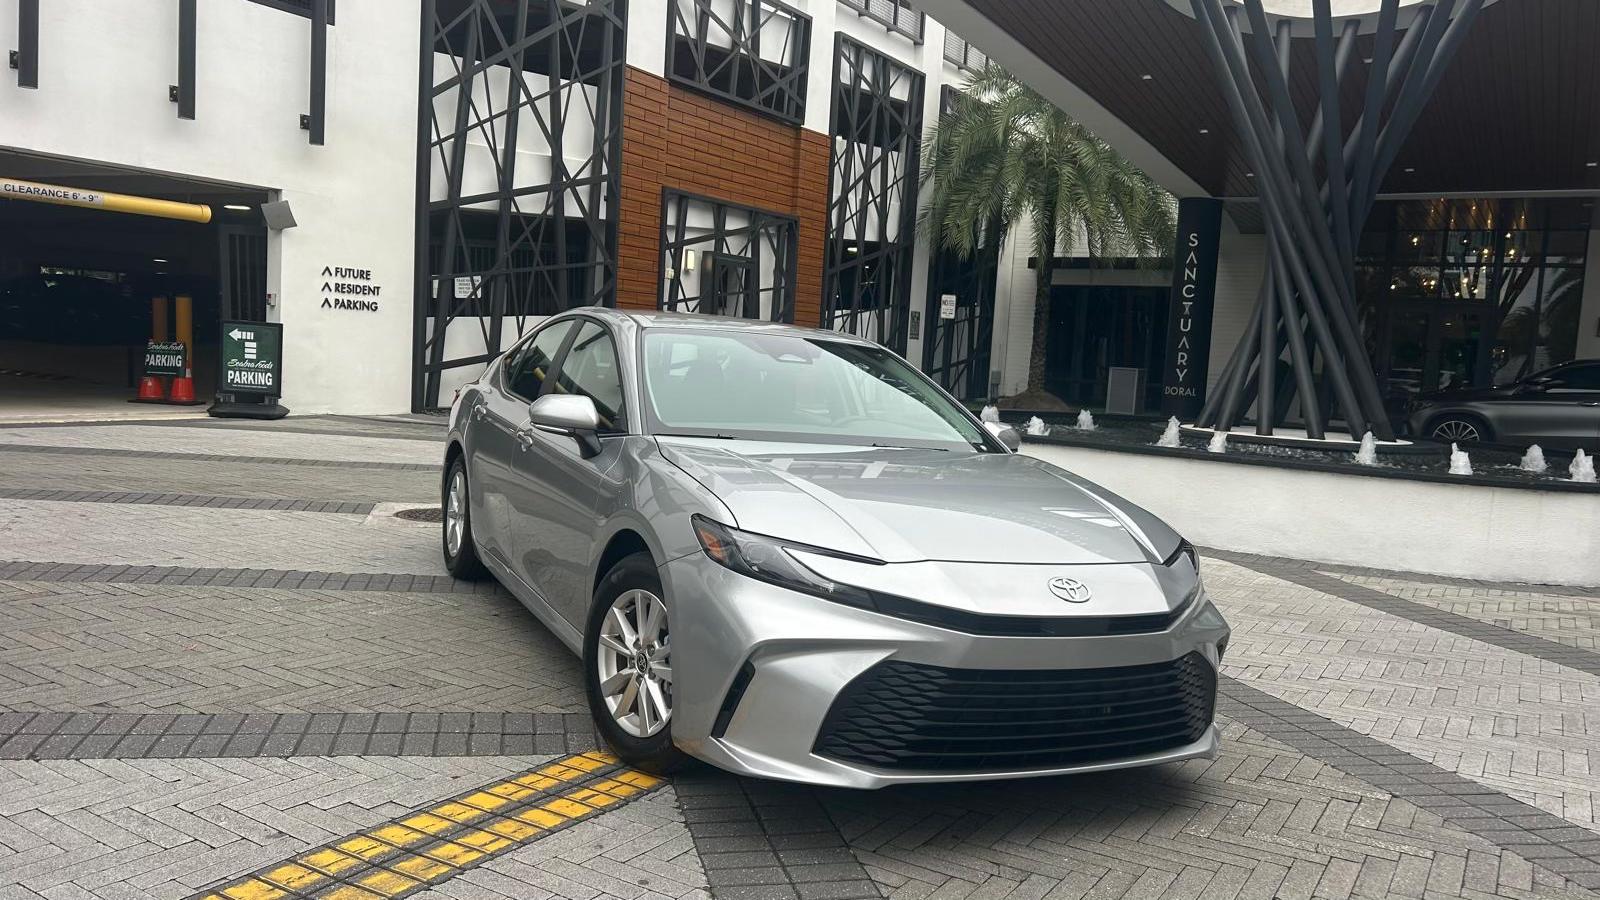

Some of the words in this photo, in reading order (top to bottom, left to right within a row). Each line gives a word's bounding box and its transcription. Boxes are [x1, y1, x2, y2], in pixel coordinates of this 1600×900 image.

[4, 183, 69, 198] CLEARANCE
[335, 267, 371, 280] FUTURE
[334, 282, 381, 296] RESIDENT
[334, 298, 378, 312] PARKING
[1176, 233, 1199, 382] SANCTUARY
[145, 354, 182, 368] PARKING
[228, 370, 273, 386] PARKING
[1164, 387, 1196, 396] DORAL
